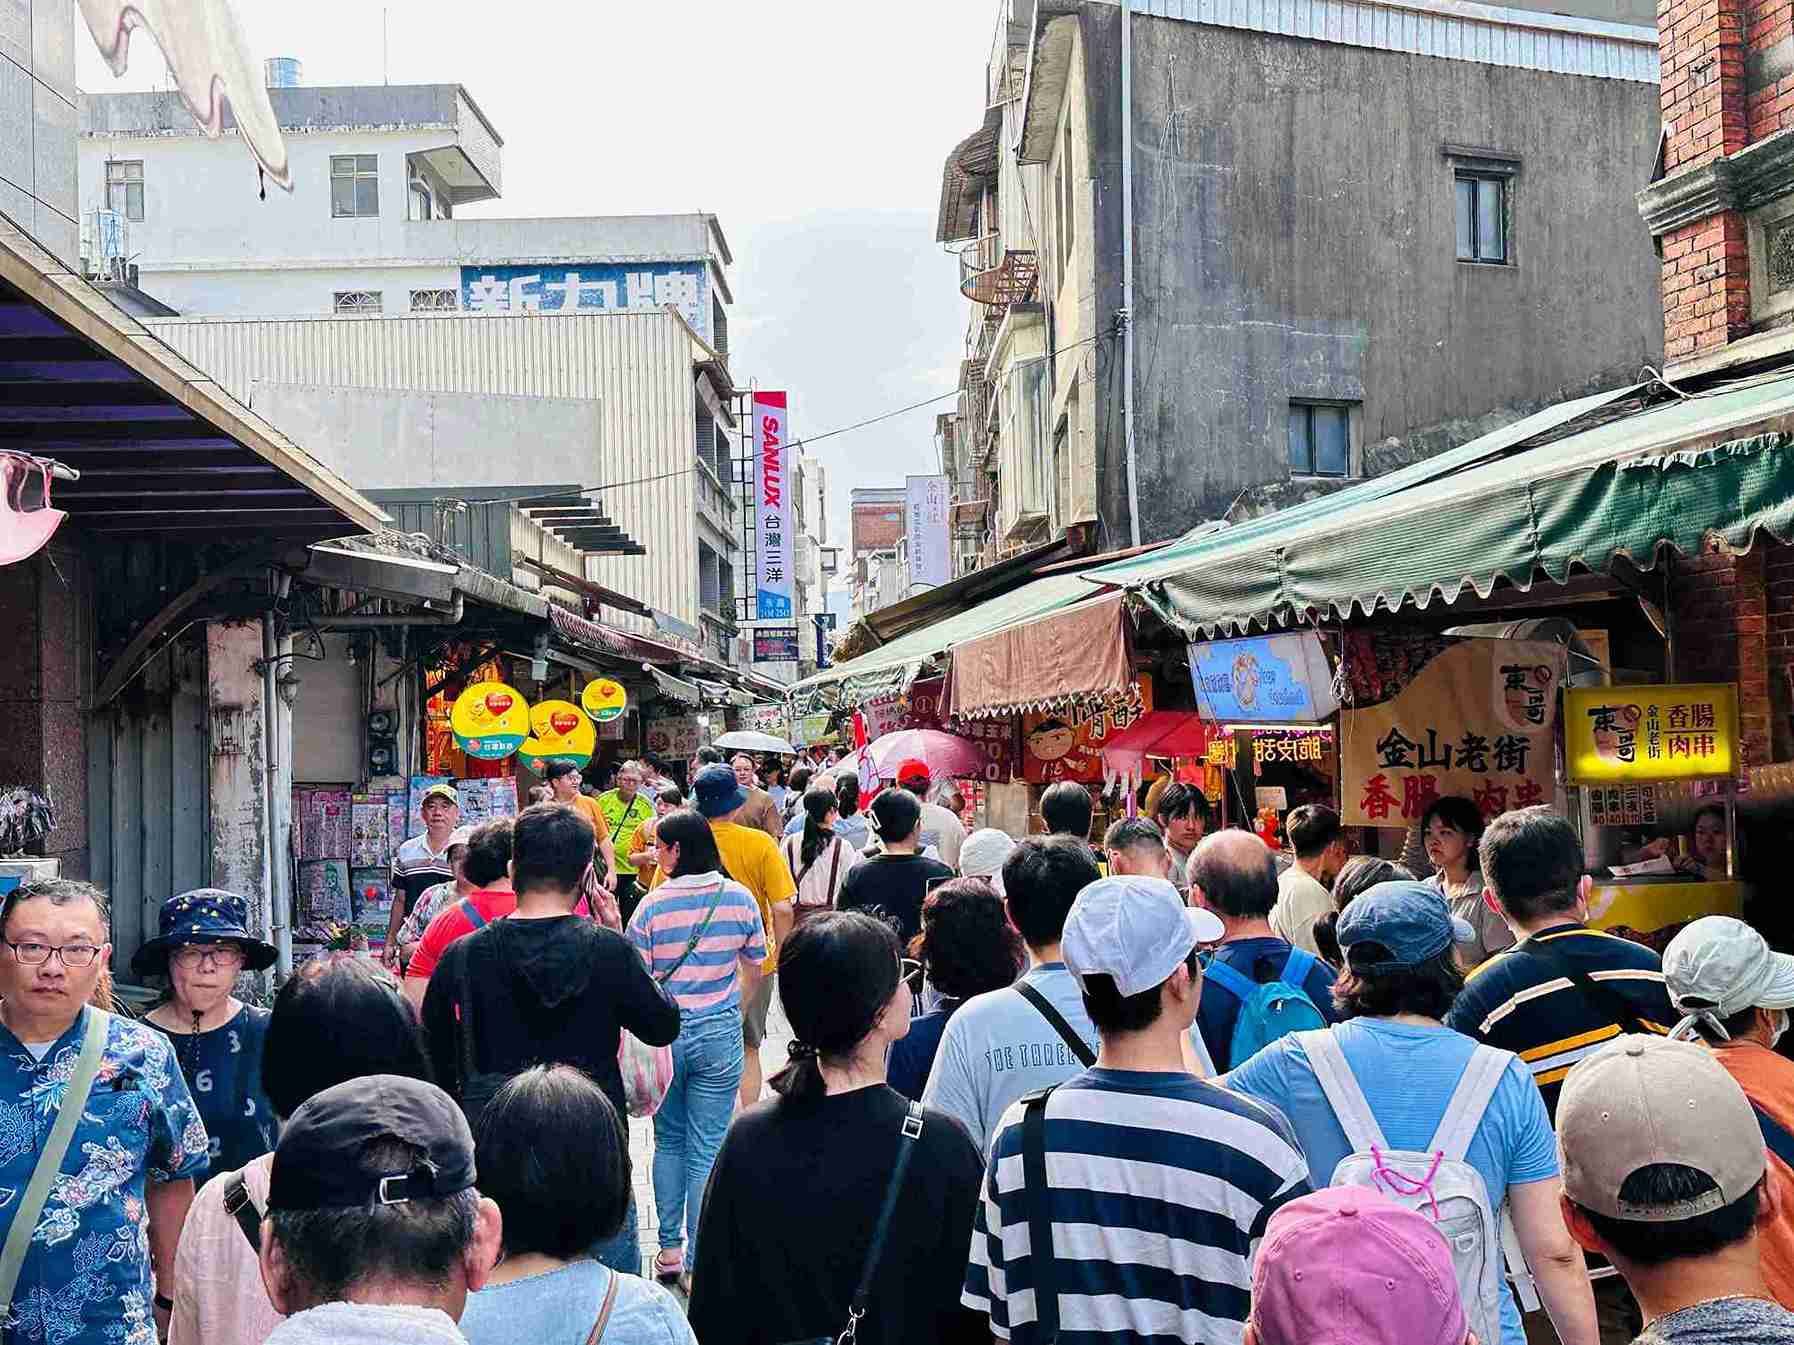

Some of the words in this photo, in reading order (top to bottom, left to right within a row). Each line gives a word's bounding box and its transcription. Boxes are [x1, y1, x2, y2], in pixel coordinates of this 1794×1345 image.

[762, 415, 780, 510] SANLUX
[764, 514, 783, 583] 台灣三洋
[1646, 704, 1662, 760] 金山老街
[1666, 703, 1715, 729] 香腸
[1376, 727, 1531, 775] 金山老街
[1667, 733, 1716, 759] 肉串
[1360, 774, 1440, 819] 香腸
[195, 1069, 213, 1092] 6
